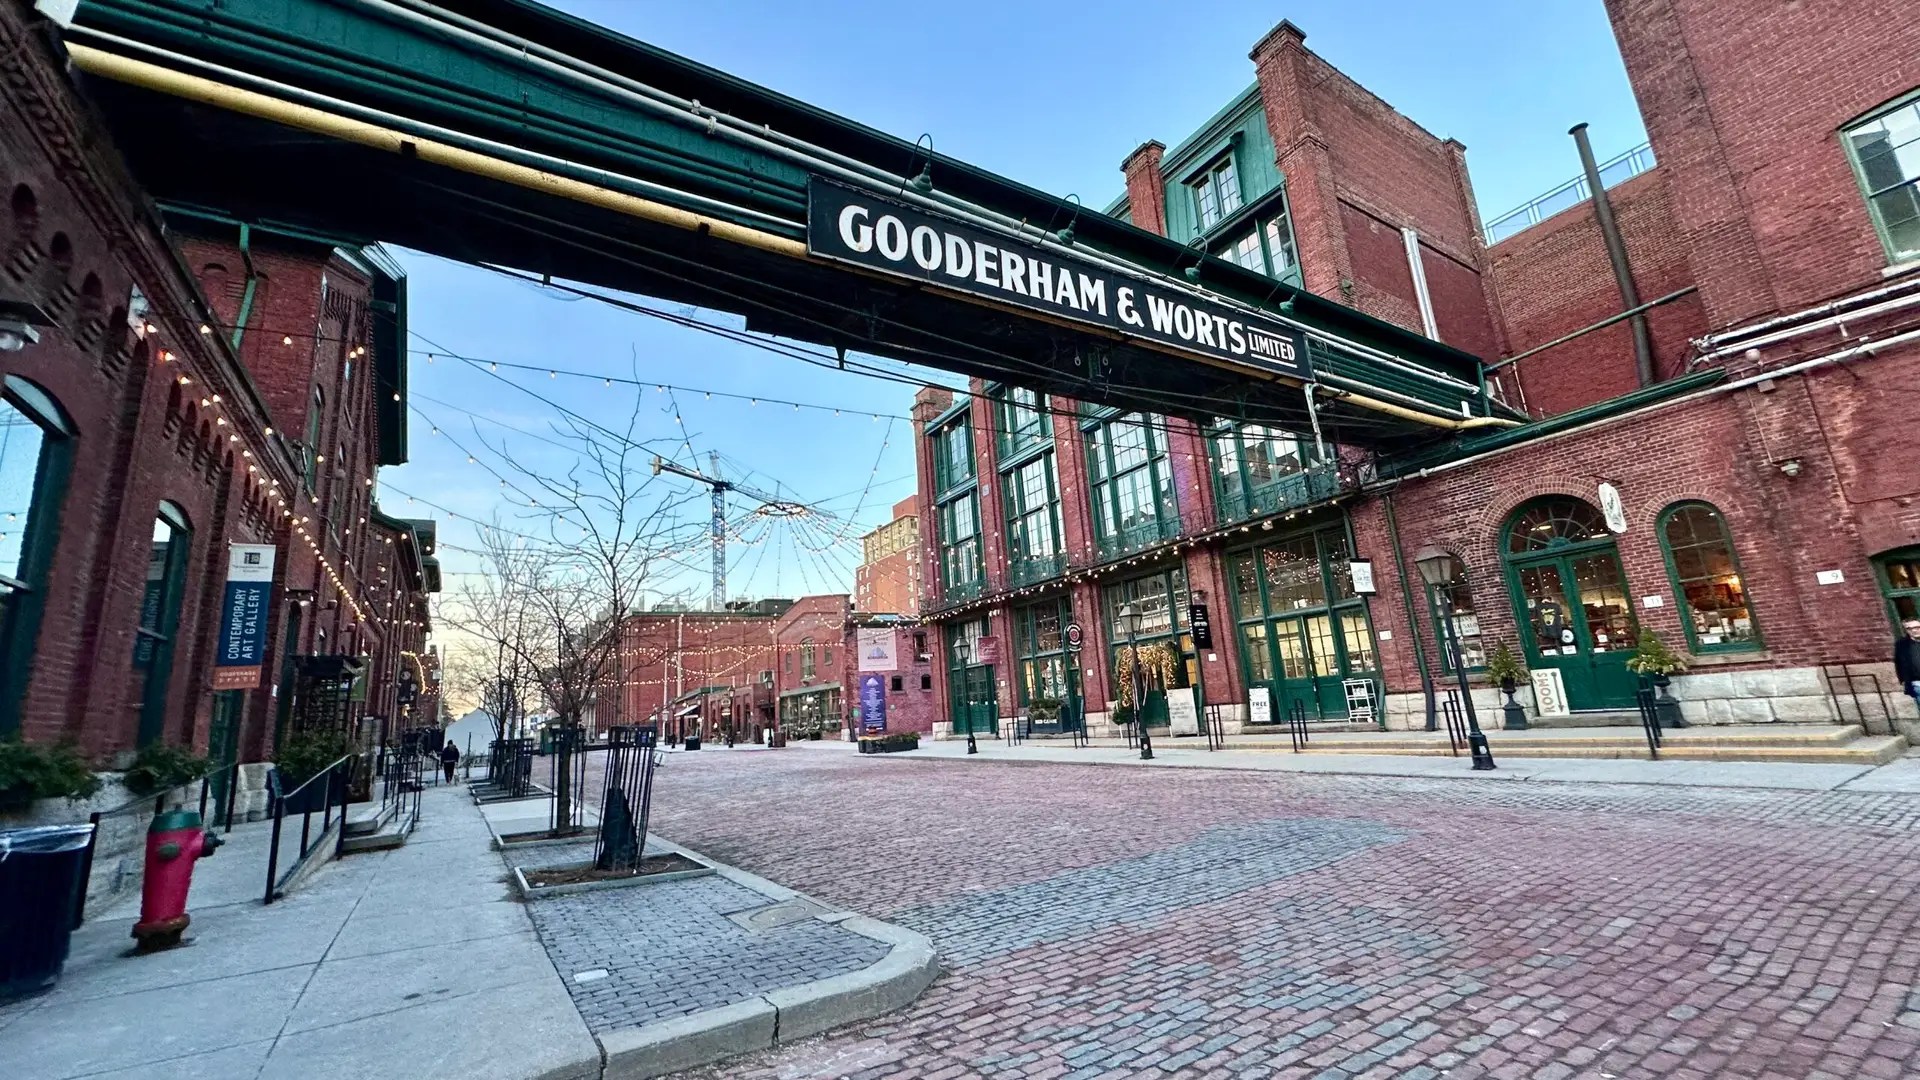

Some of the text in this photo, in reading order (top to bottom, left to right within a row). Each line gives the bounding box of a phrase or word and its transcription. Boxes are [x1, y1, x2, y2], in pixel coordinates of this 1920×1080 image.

[838, 203, 1296, 362] GOODERHAM & WORTS LIMITED
[228, 588, 246, 660] CONTEMPORARY
[242, 588, 260, 660] ART GALLERY
[1536, 671, 1556, 713] ROOMS
